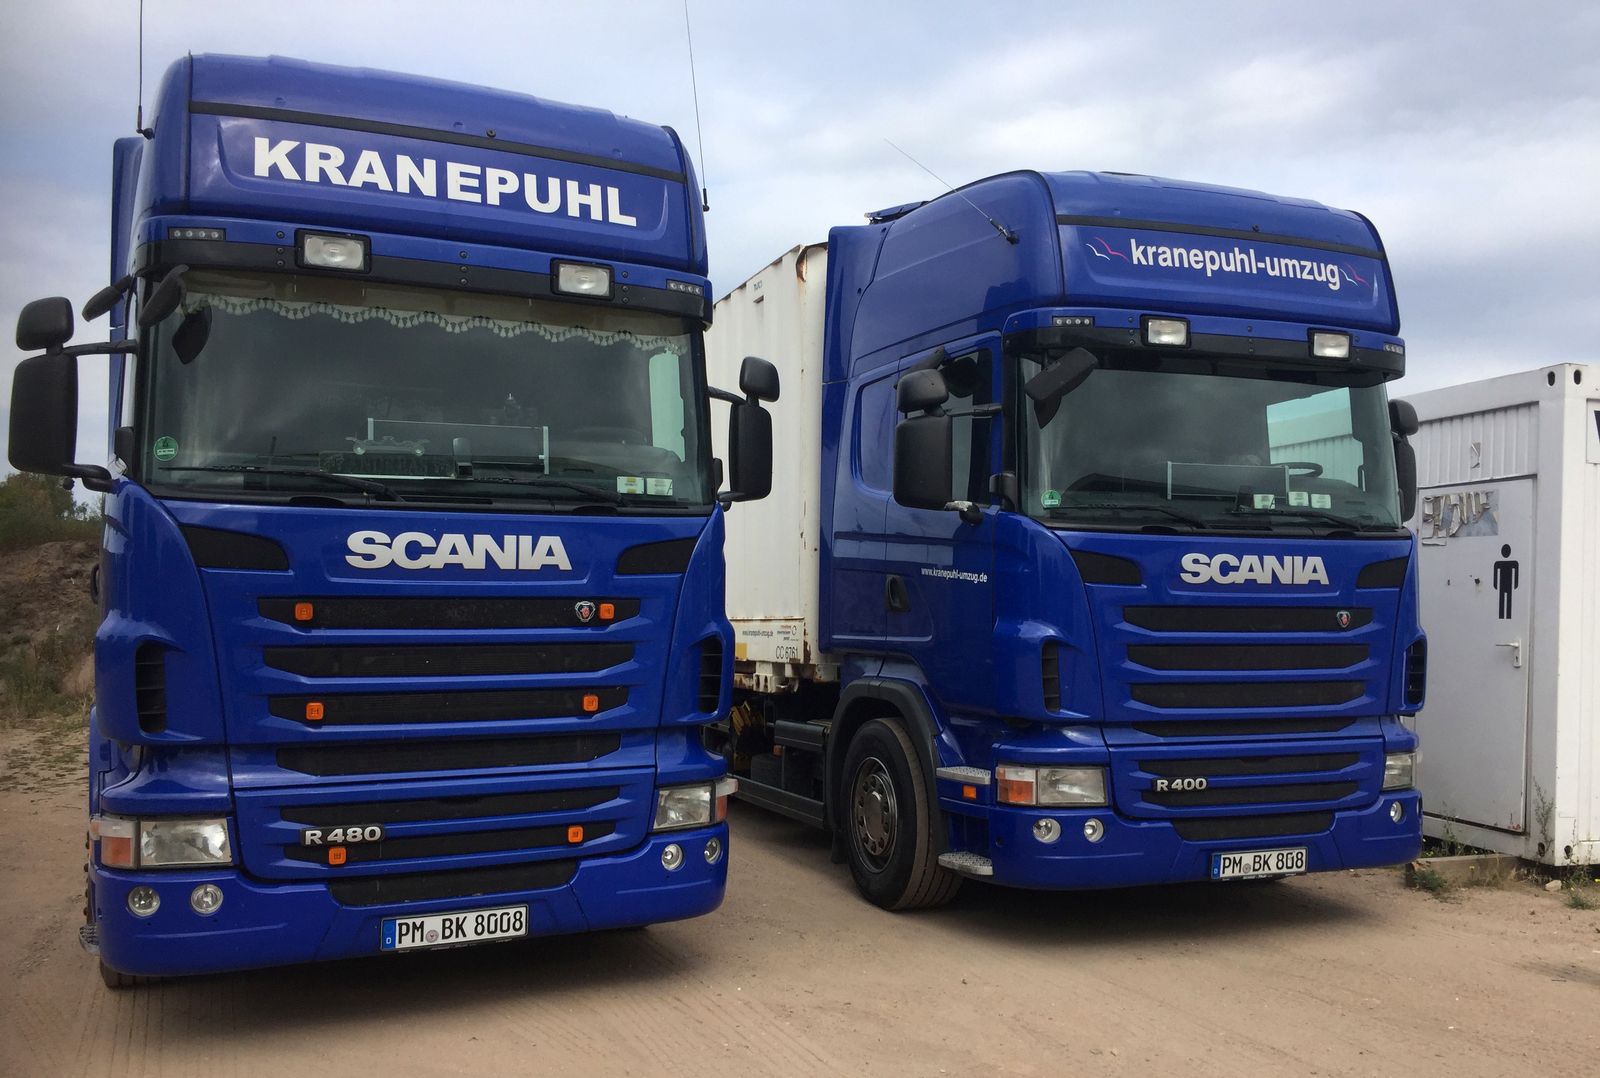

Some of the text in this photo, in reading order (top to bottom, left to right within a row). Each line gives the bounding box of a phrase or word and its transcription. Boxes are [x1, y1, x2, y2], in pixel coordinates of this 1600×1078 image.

[253, 136, 637, 227] KRANEPUHL
[1130, 238, 1341, 291] kranepuhl-umzug
[345, 530, 572, 570] SCANIA
[921, 567, 988, 584] www.kranepuhl-umzug.de
[1180, 552, 1329, 585] SCANIA
[1156, 778, 1207, 791] R 400
[305, 826, 381, 845] R 480
[1222, 856, 1243, 874] PM
[1252, 854, 1272, 872] BK
[1276, 852, 1304, 868] 808
[398, 921, 425, 945] PM
[442, 916, 467, 940] BK
[474, 911, 523, 936] 8008
